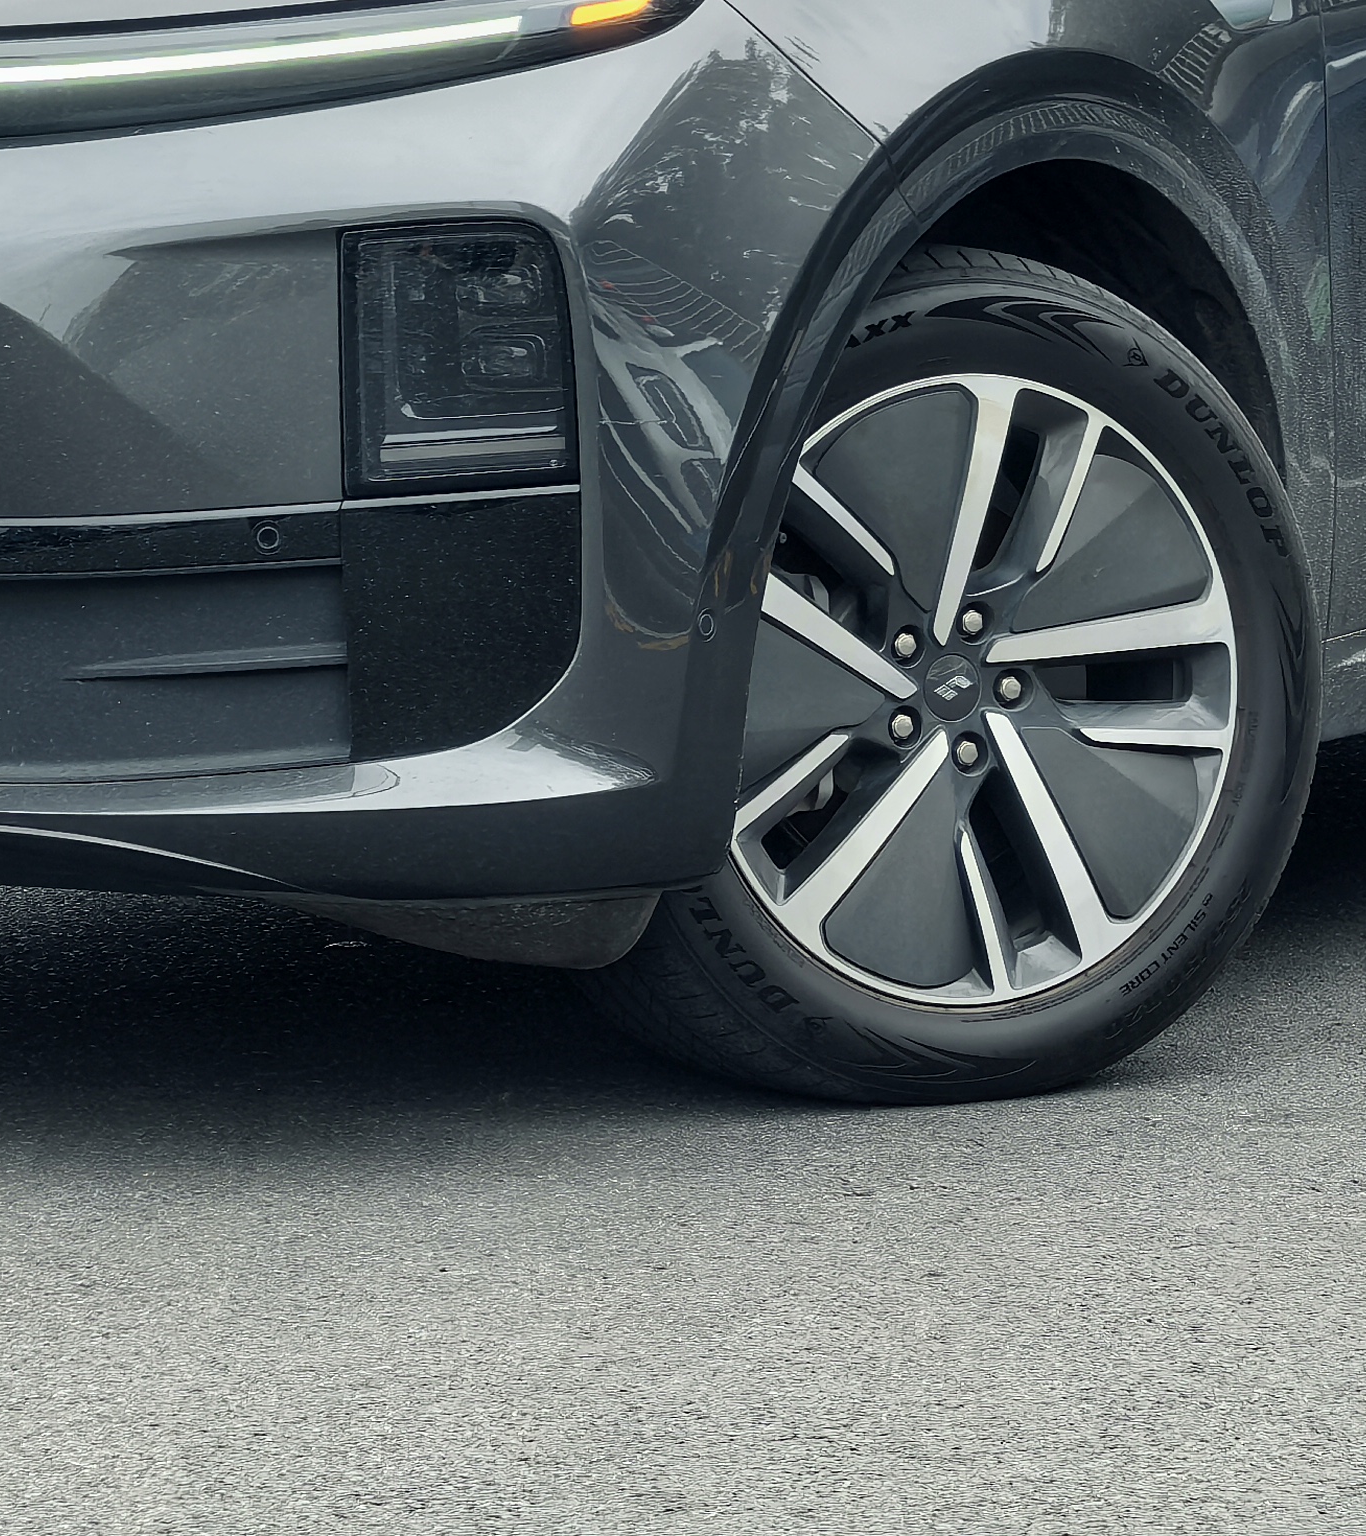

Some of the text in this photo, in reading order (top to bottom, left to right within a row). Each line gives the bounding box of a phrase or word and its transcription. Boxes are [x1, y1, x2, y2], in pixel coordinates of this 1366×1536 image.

[1153, 368, 1291, 558] DUNLOP
[682, 885, 801, 1014] DUNL
[1118, 909, 1208, 998] SILENT CORE
